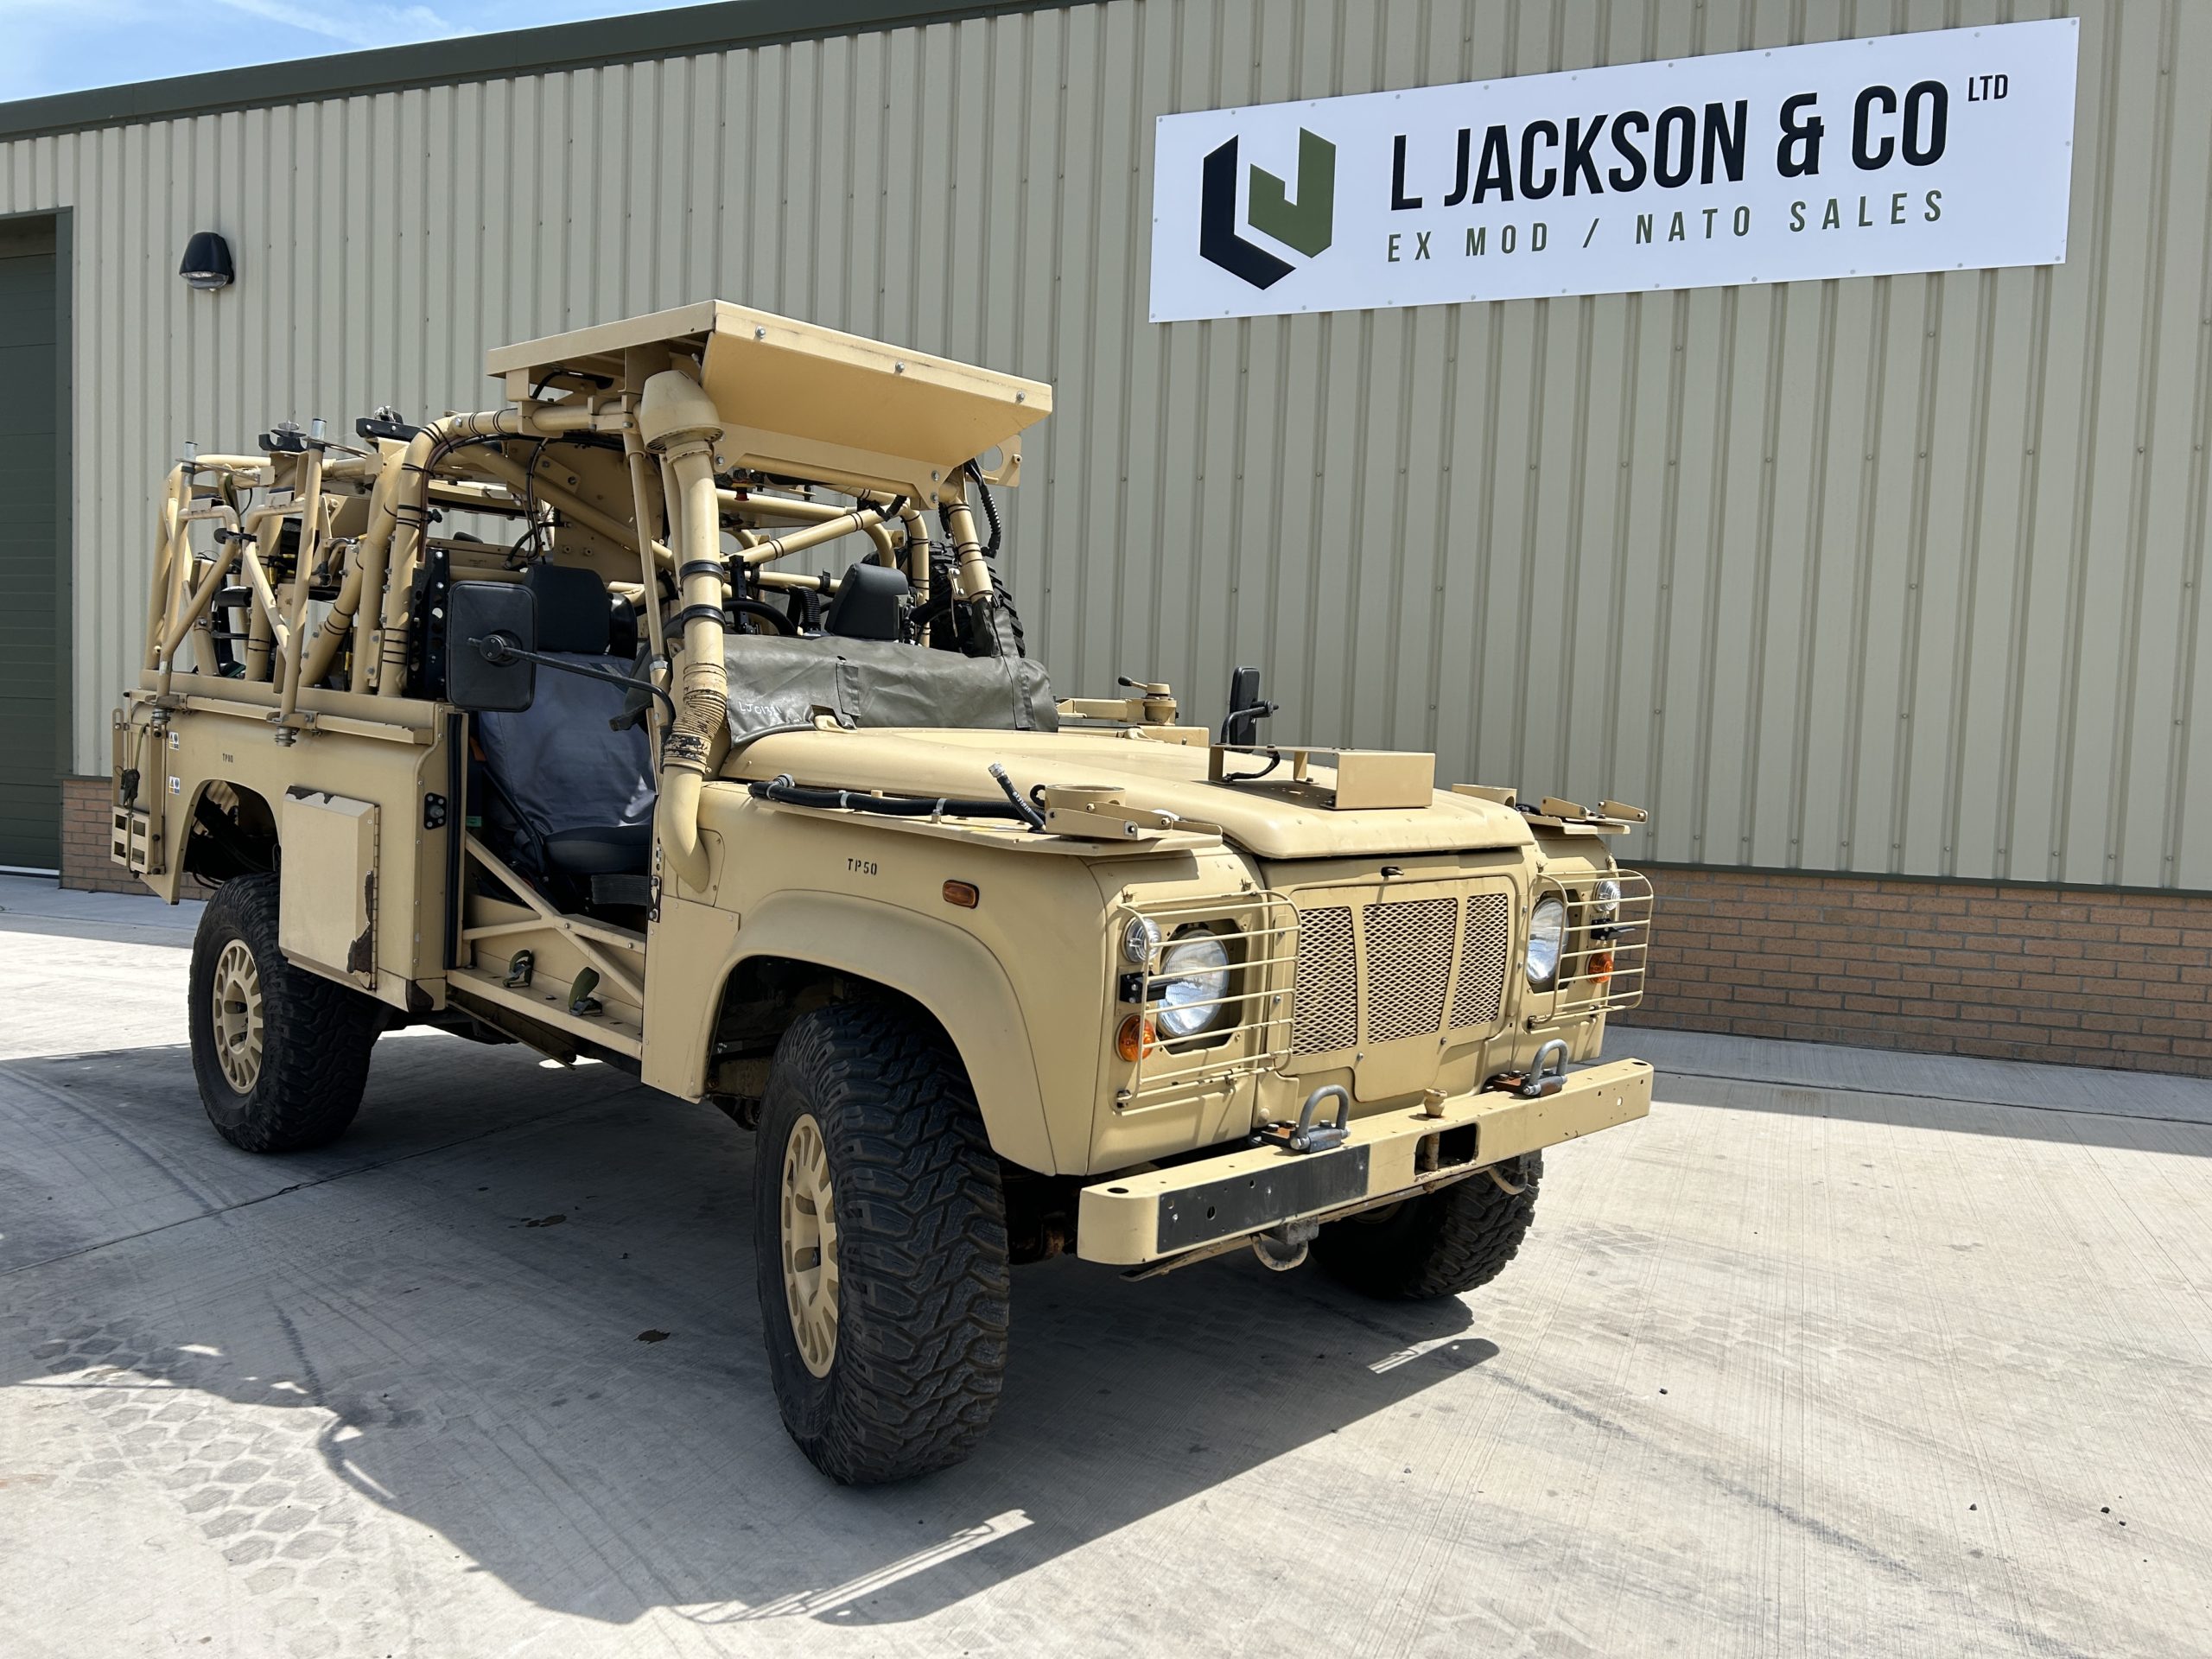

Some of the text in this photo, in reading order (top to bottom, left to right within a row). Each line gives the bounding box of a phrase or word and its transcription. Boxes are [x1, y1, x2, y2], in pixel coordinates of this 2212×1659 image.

[1390, 73, 2009, 212] L JACKSON & CO LTD
[1387, 189, 1943, 263] EX MOD / NATO SALES
